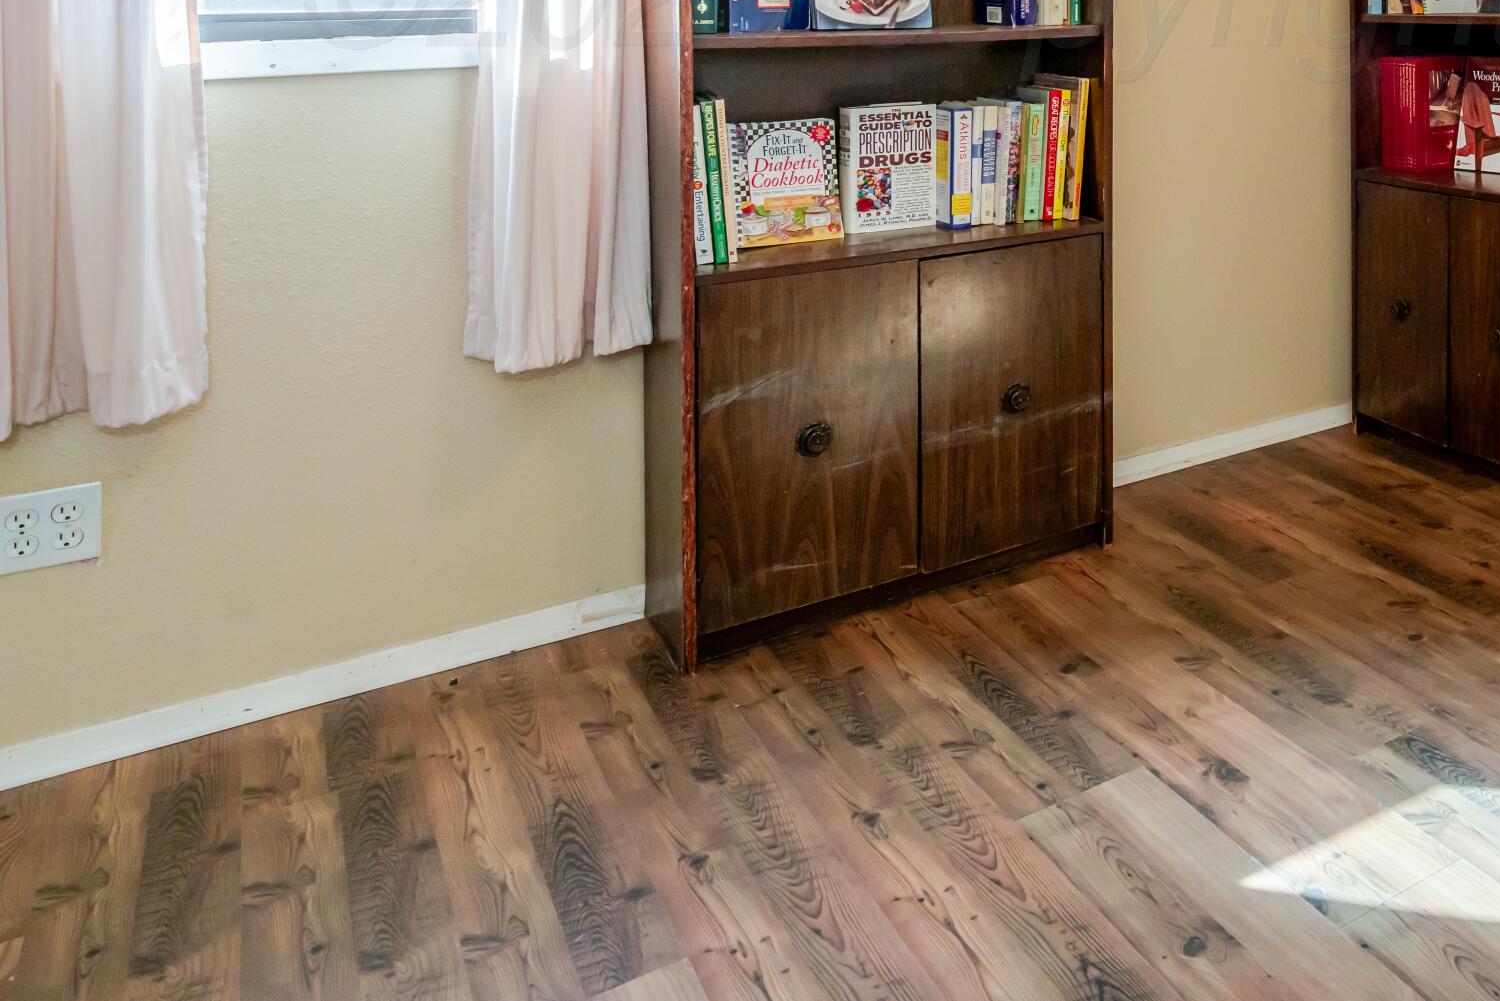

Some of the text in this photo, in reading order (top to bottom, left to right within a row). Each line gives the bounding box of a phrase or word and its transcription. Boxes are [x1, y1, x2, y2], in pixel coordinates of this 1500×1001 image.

[859, 110, 932, 123] ESSENTIAL
[1050, 96, 1059, 116] GREAT
[704, 104, 717, 158] RECIPES FOR LIFE
[858, 119, 932, 131] GUIDE TO
[1049, 116, 1058, 140] RECIPES
[792, 136, 804, 144] and
[859, 128, 932, 155] PRESCRIPTION
[959, 121, 970, 161] Atkins
[753, 153, 820, 173] Diabetic
[859, 151, 932, 169] DRUGS
[983, 136, 991, 178] SOLUTION
[751, 168, 824, 189] Cookbook
[694, 190, 706, 242] Entertaining
